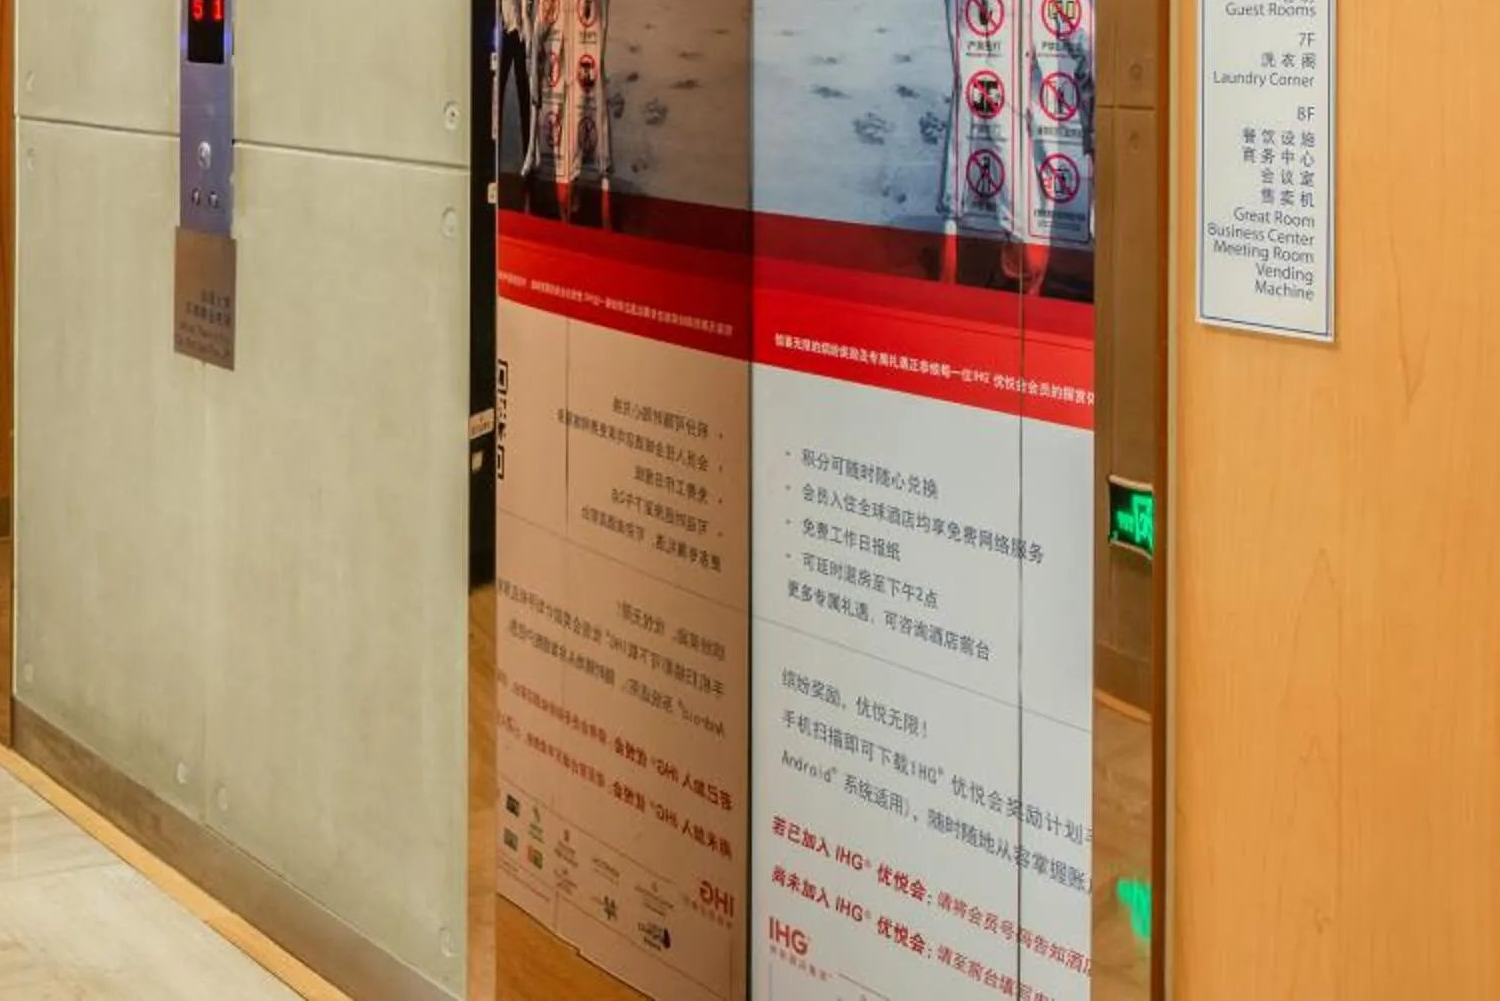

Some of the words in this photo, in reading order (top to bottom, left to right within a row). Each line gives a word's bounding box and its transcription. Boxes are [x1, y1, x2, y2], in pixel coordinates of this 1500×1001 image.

[1225, 1, 1265, 17] Guest
[1268, 2, 1317, 17] Rooms
[1297, 32, 1316, 47] 7F
[1213, 71, 1267, 88] Laundry
[1269, 73, 1315, 88] Corner
[1243, 127, 1316, 148] 餐饮设施
[1242, 146, 1316, 168] 商务中心
[1260, 167, 1315, 188] 会议室
[1260, 187, 1315, 208] 售卖机
[1234, 207, 1270, 224] Great
[1274, 210, 1315, 228] Room
[1207, 222, 1264, 242] Business
[1267, 228, 1314, 247] Center
[1213, 239, 1269, 261] Meeting
[1273, 246, 1314, 264] Room
[1255, 263, 1314, 286] Vending
[1255, 280, 1315, 300] Machine
[771, 815, 831, 858] 若已加入
[771, 865, 831, 909] 尚未加入
[769, 916, 809, 956] IHG
